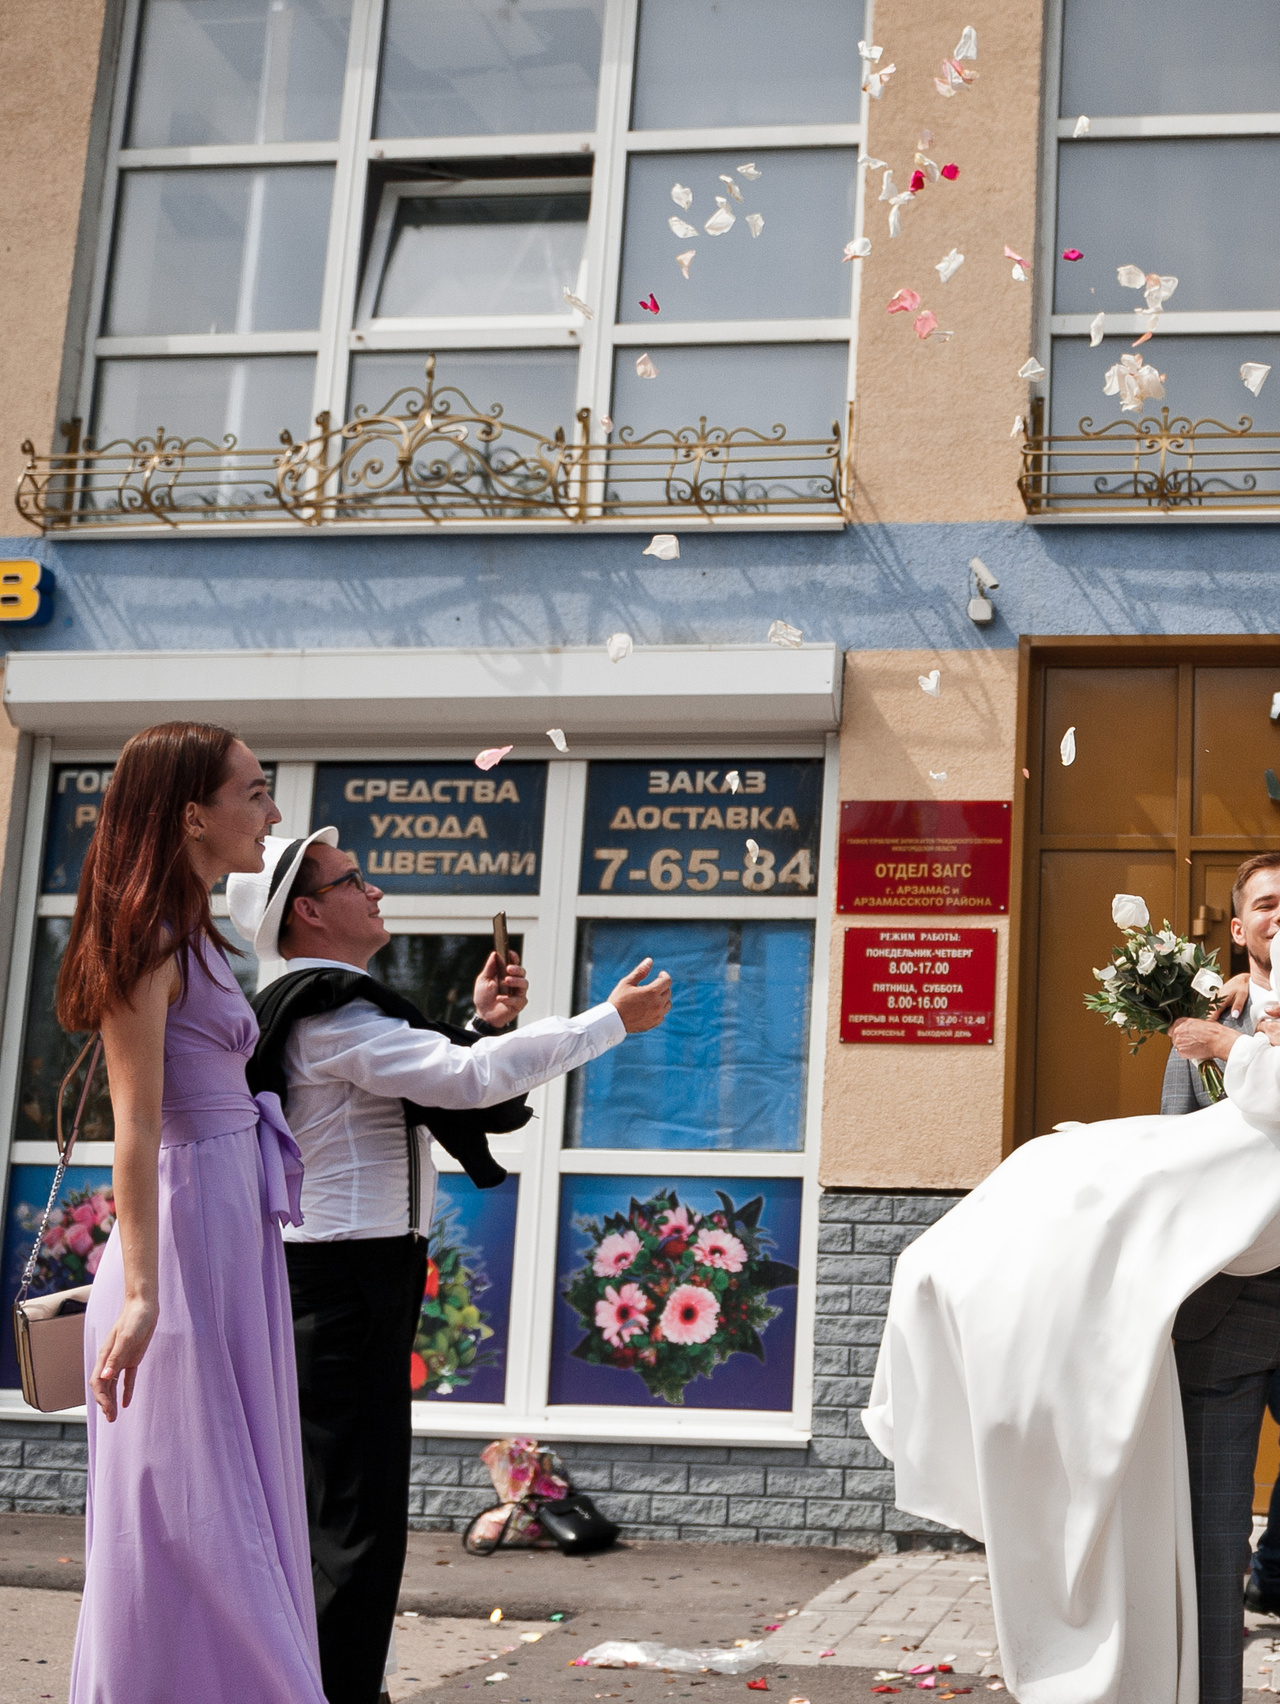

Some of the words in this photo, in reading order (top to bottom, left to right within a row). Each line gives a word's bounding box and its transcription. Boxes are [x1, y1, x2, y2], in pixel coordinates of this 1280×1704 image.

[648, 769, 766, 794] ЗАКАЗ
[344, 778, 520, 804] СРЕДСТВА
[609, 805, 799, 830] ДОСТАВКА
[369, 814, 489, 839] УХОДА
[367, 850, 536, 876] ЦВЕТАМИ
[594, 848, 814, 892] 7-65-84
[875, 863, 929, 880] ОТДЕЛ
[932, 863, 972, 878] ЗАГС
[896, 885, 951, 895] АРЗАМАС
[853, 897, 944, 907] АРЗАМАССКОГО
[945, 896, 992, 907] РАЙОНА
[880, 932, 915, 941] РЕЖИМ
[920, 932, 961, 941] РАБОТЫ:
[866, 948, 973, 958] ПОНЕДЕЛЬНИК-ЧЕТВЕРГ
[889, 962, 949, 975] 8.00-17.00
[872, 983, 918, 994] ПЯТНИЦА,
[922, 983, 964, 993] СУББОТА
[887, 996, 948, 1009] 8.00-16.00
[848, 1014, 886, 1023] ПЕРЕРЫВ
[902, 1015, 924, 1024] ОБЕД
